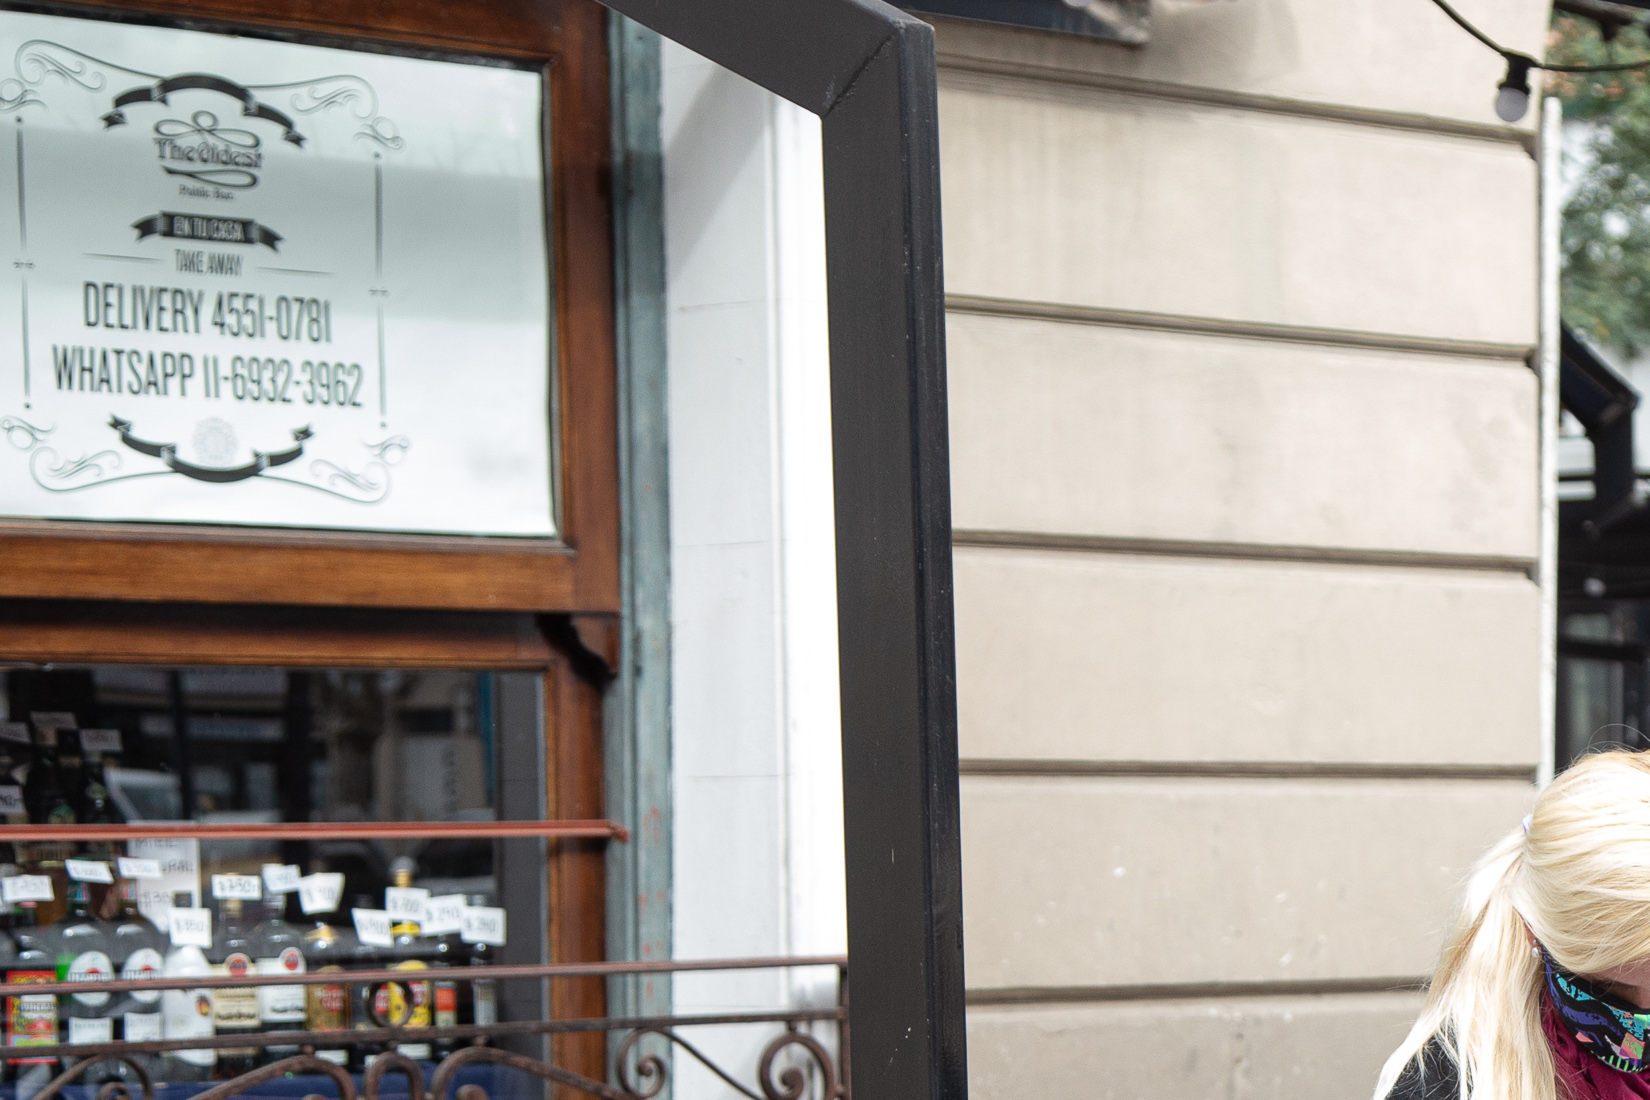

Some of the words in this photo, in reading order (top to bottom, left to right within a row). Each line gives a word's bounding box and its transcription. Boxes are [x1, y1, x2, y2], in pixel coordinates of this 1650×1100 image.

[154, 138, 196, 161] The
[197, 142, 263, 168] Oldest
[174, 249, 204, 274] TAKE
[206, 251, 244, 277] AWAY
[83, 281, 204, 334] DELIVERY
[211, 290, 332, 343] 4551-0781
[51, 344, 195, 397] WHATSAPP
[202, 354, 364, 408] 11-6932-3962
